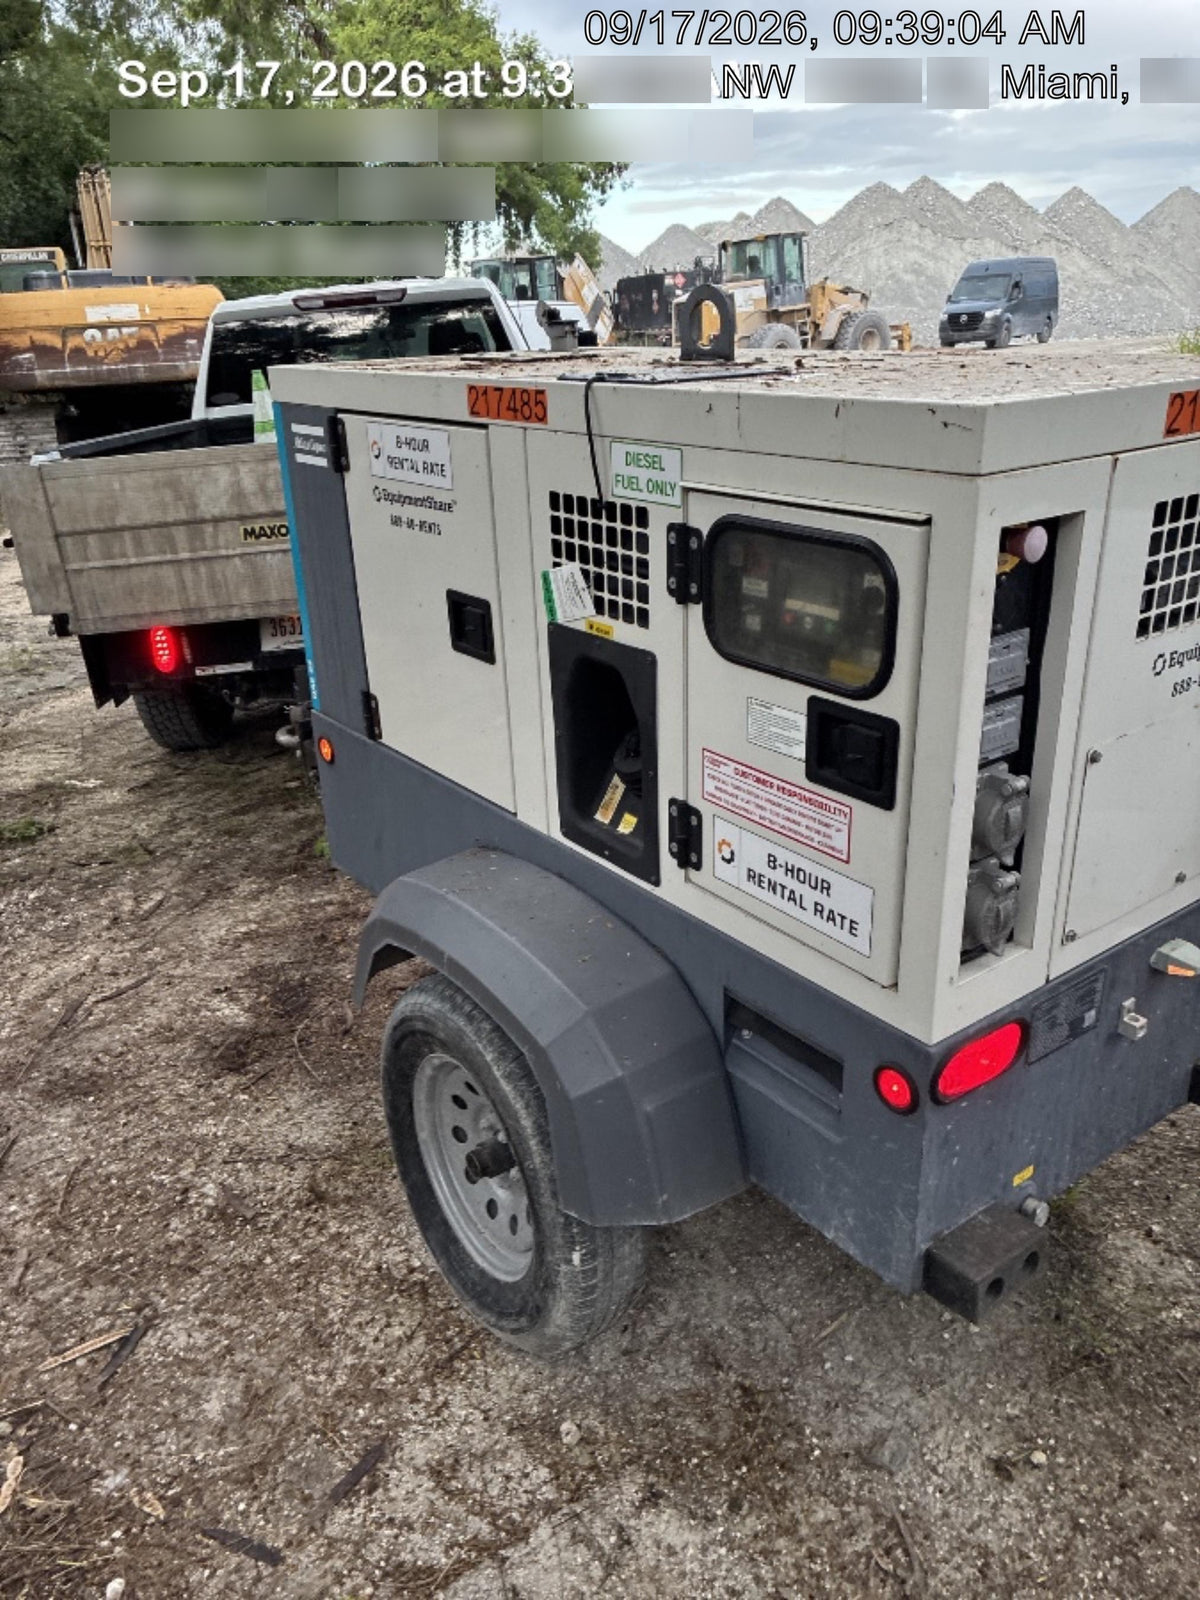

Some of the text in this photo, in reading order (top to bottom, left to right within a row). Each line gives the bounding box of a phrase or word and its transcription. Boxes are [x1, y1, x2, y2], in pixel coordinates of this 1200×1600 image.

[468, 385, 547, 421] 217485
[386, 454, 447, 478] RENTAL RATE
[624, 450, 666, 472] DIESEL
[614, 473, 677, 499] FUEL ONLY
[1171, 673, 1200, 698] 888-
[746, 866, 861, 938] RENTAL RATE
